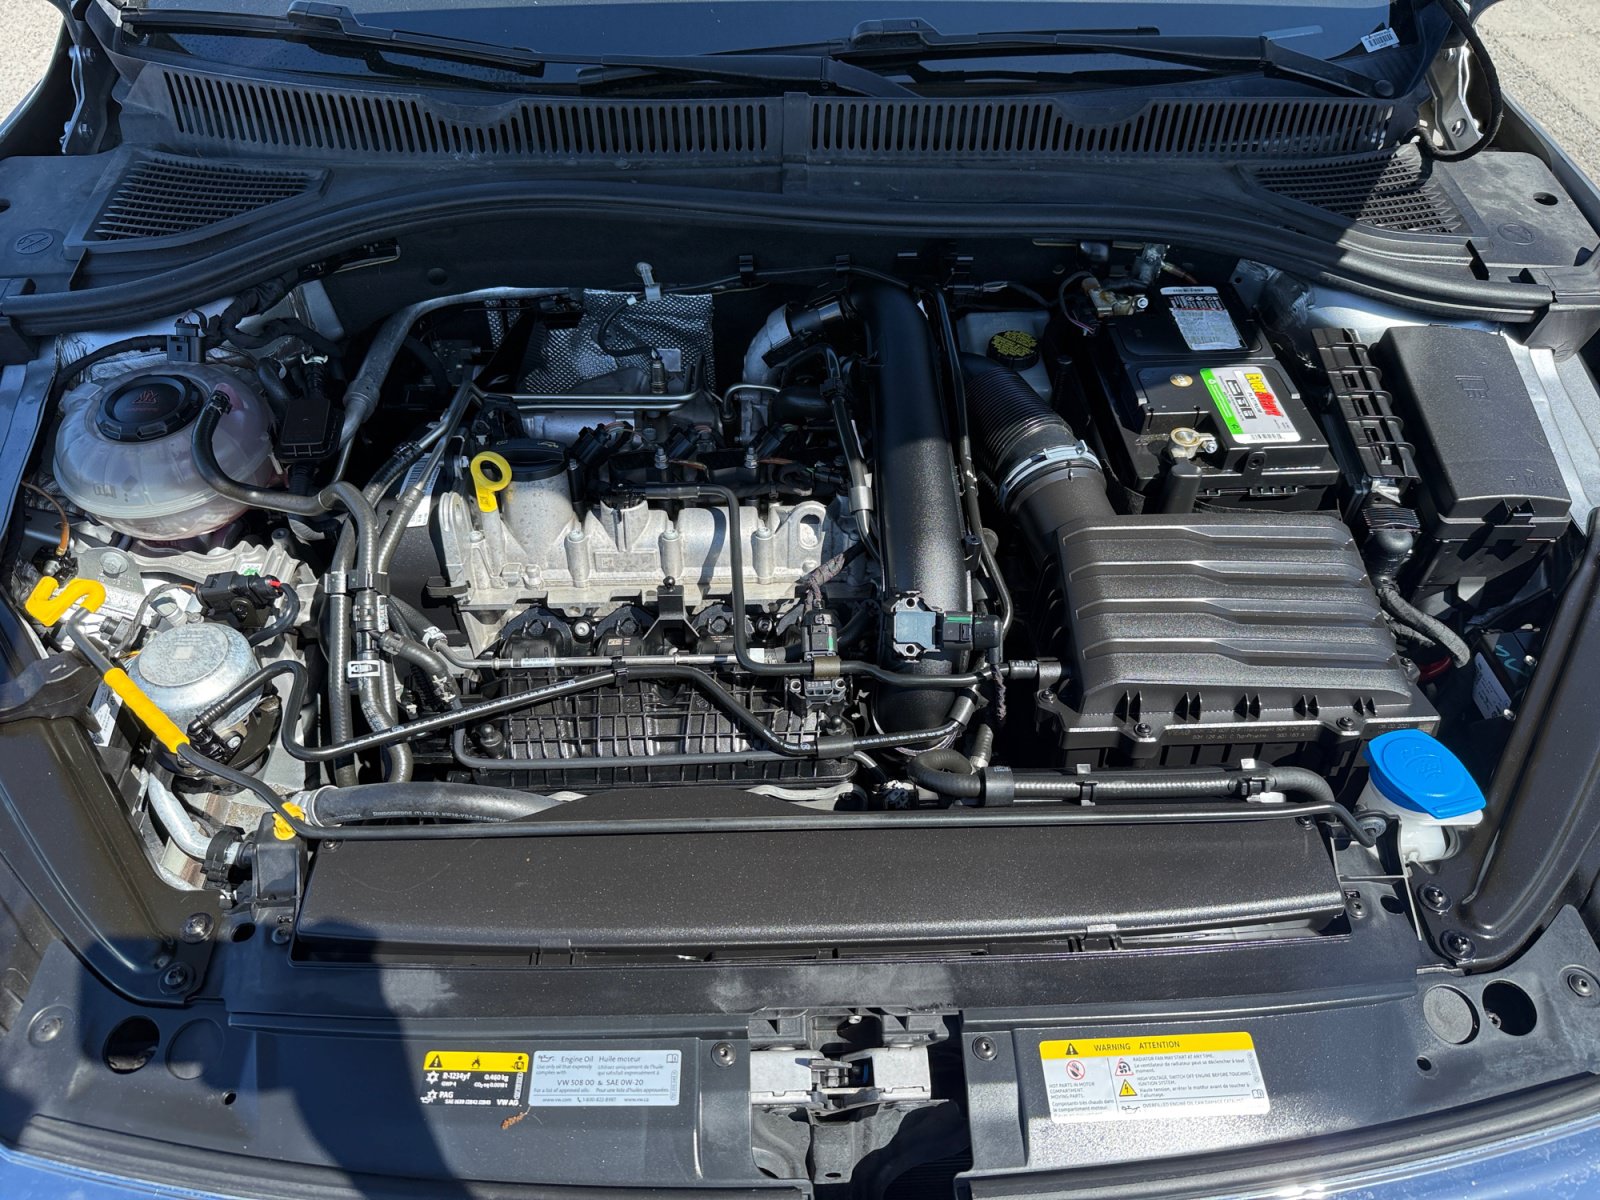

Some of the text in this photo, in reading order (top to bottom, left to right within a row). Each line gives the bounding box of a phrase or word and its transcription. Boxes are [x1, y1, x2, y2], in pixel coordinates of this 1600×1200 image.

[1093, 1041, 1180, 1051] WARNING ATTENTION
[561, 1056, 583, 1064] Engine
[442, 1072, 471, 1081] R-1234yf
